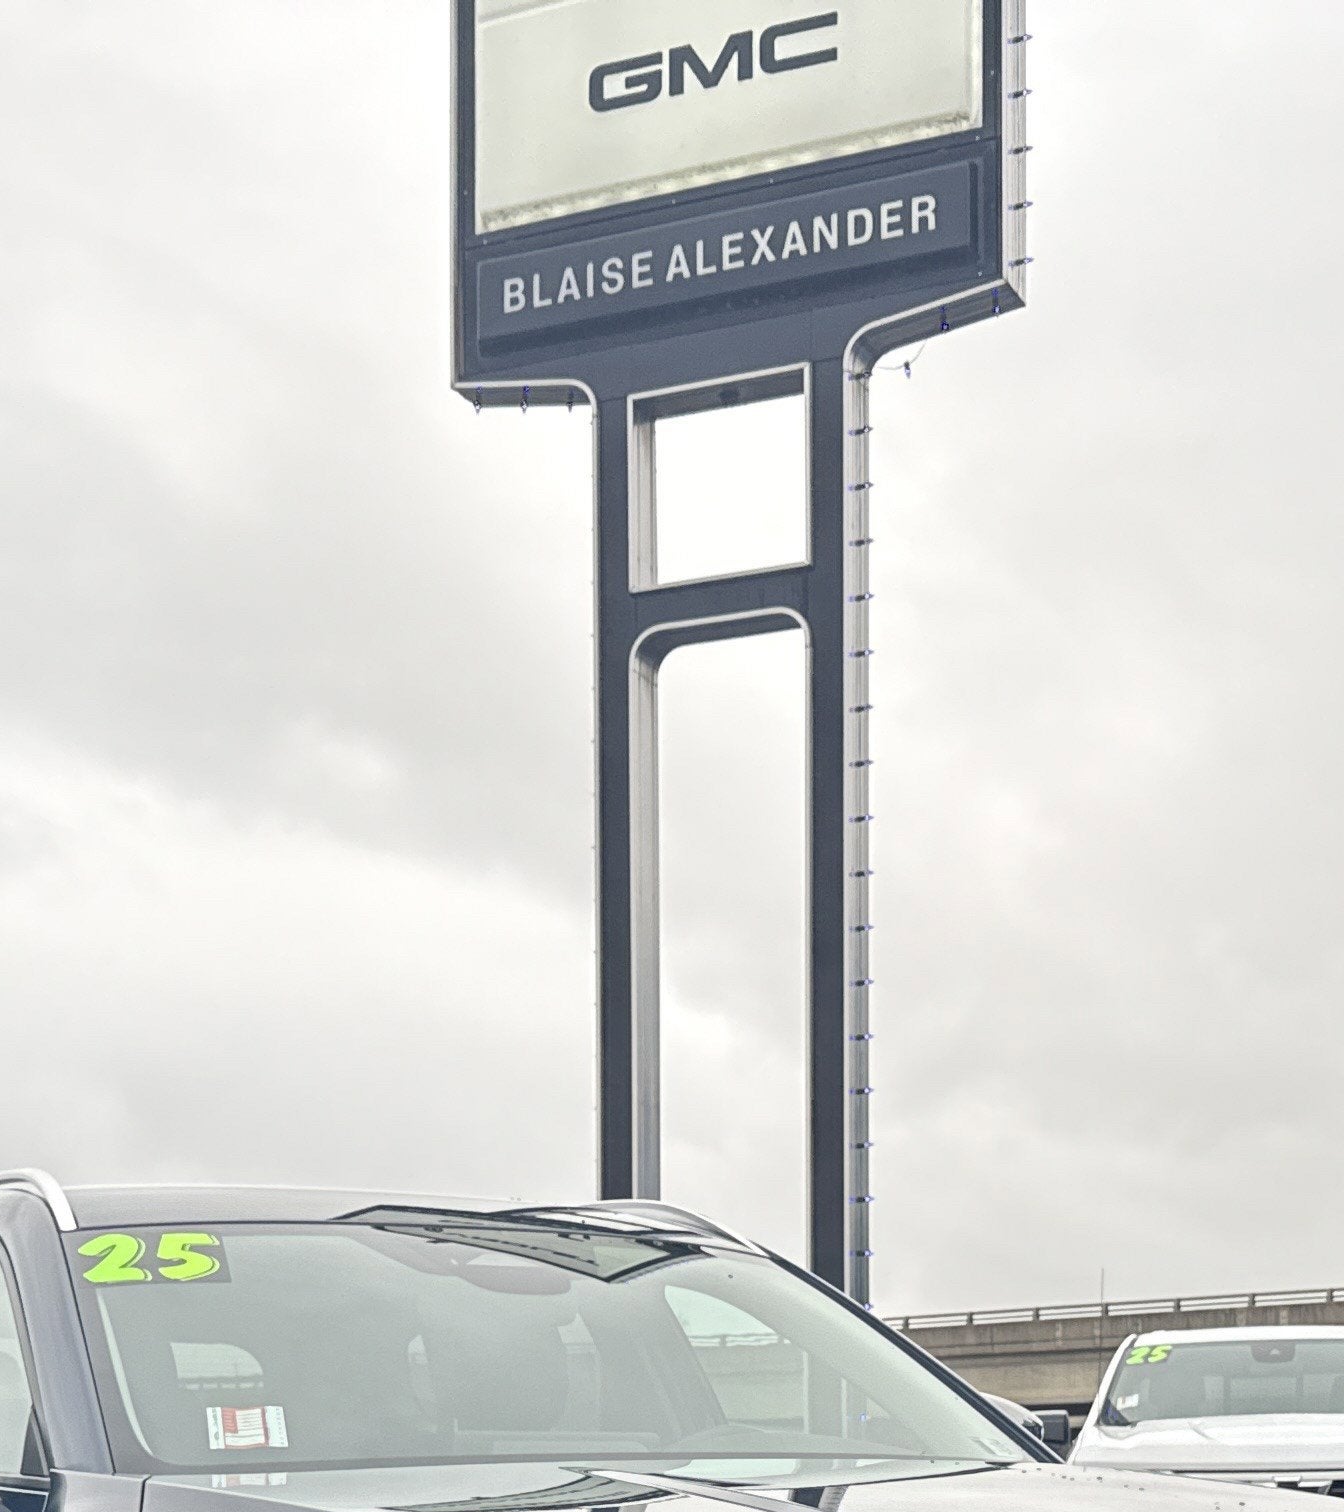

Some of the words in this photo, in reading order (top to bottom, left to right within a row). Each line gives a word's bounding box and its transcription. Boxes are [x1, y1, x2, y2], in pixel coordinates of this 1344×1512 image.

[588, 11, 838, 113] GMC
[502, 250, 654, 314] BLAISE
[665, 194, 937, 283] ALEXANDER
[77, 1233, 221, 1283] 25
[1125, 1345, 1173, 1365] 25
